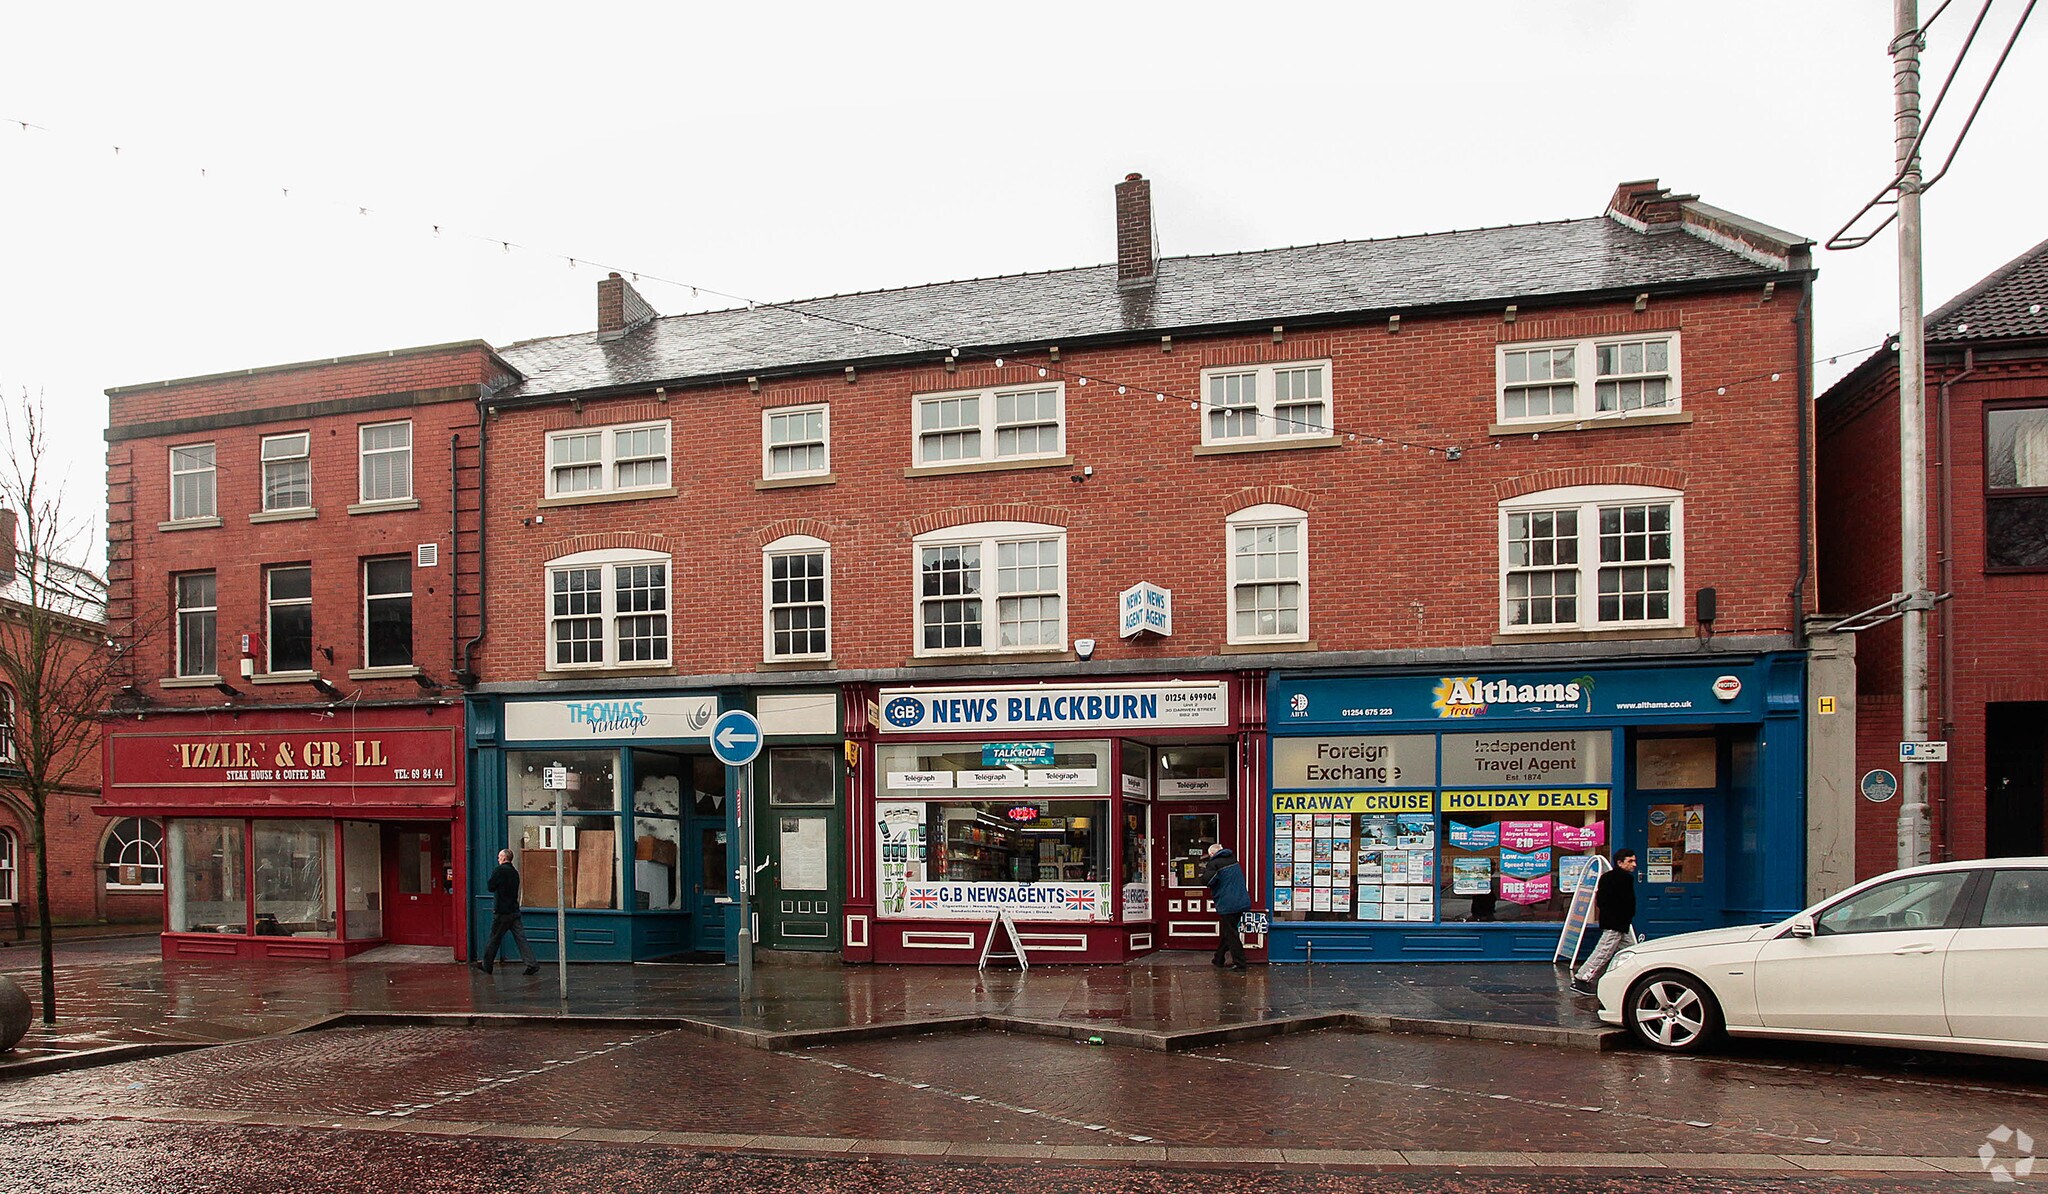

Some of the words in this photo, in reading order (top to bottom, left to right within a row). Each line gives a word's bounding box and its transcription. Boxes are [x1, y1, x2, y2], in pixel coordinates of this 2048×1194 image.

[1126, 590, 1142, 611] NEWS
[1146, 589, 1165, 609] NEWS
[1125, 609, 1143, 630] AGENT
[1145, 609, 1167, 629] AGENT
[1165, 693, 1186, 702] 01254
[1189, 692, 1217, 701] 699904
[1446, 679, 1580, 705] Althams
[566, 701, 644, 723] THOMAS
[894, 705, 916, 719] GB
[932, 698, 998, 724] NEWS
[1007, 693, 1157, 722] BLACKBURN
[1364, 708, 1378, 716] 675
[1450, 704, 1489, 716] travel
[1616, 700, 1692, 710] www.althams.co.uk
[1820, 698, 1833, 712] H
[586, 715, 651, 735] Vintage
[172, 742, 266, 768] IZZLE
[275, 741, 296, 767] &
[303, 740, 388, 767] GRLL
[993, 749, 1017, 757] TALK
[1018, 748, 1046, 757] HOME
[1317, 743, 1389, 762] Foreign
[1475, 739, 1576, 755] Independent
[1475, 758, 1523, 771] Travel
[1528, 757, 1576, 773] Agent
[226, 770, 248, 780] STEAK
[251, 770, 273, 780] HOUSE
[275, 770, 281, 780] &
[283, 770, 309, 780] COFFEE
[311, 769, 326, 780] BAR
[394, 769, 410, 779] TEL:
[411, 769, 420, 779] 69
[434, 768, 443, 778] 44
[904, 775, 935, 783] Telegraph
[974, 774, 1006, 782] Telegraph
[1045, 772, 1079, 780] Telegraph
[1307, 765, 1402, 783] Exchange
[1176, 781, 1209, 790] Telegraph
[1276, 796, 1354, 810] FARAWAY
[1366, 795, 1429, 809] CRUISE
[1450, 793, 1531, 807] HOLIDAY
[1538, 793, 1599, 806] DEALS
[1008, 807, 1038, 820] OPEN
[1451, 831, 1468, 840] FREE
[1516, 838, 1534, 848] £10
[939, 887, 963, 902] G.B
[967, 887, 1065, 903] NEWSAGENTS
[1503, 883, 1525, 894] FREE
